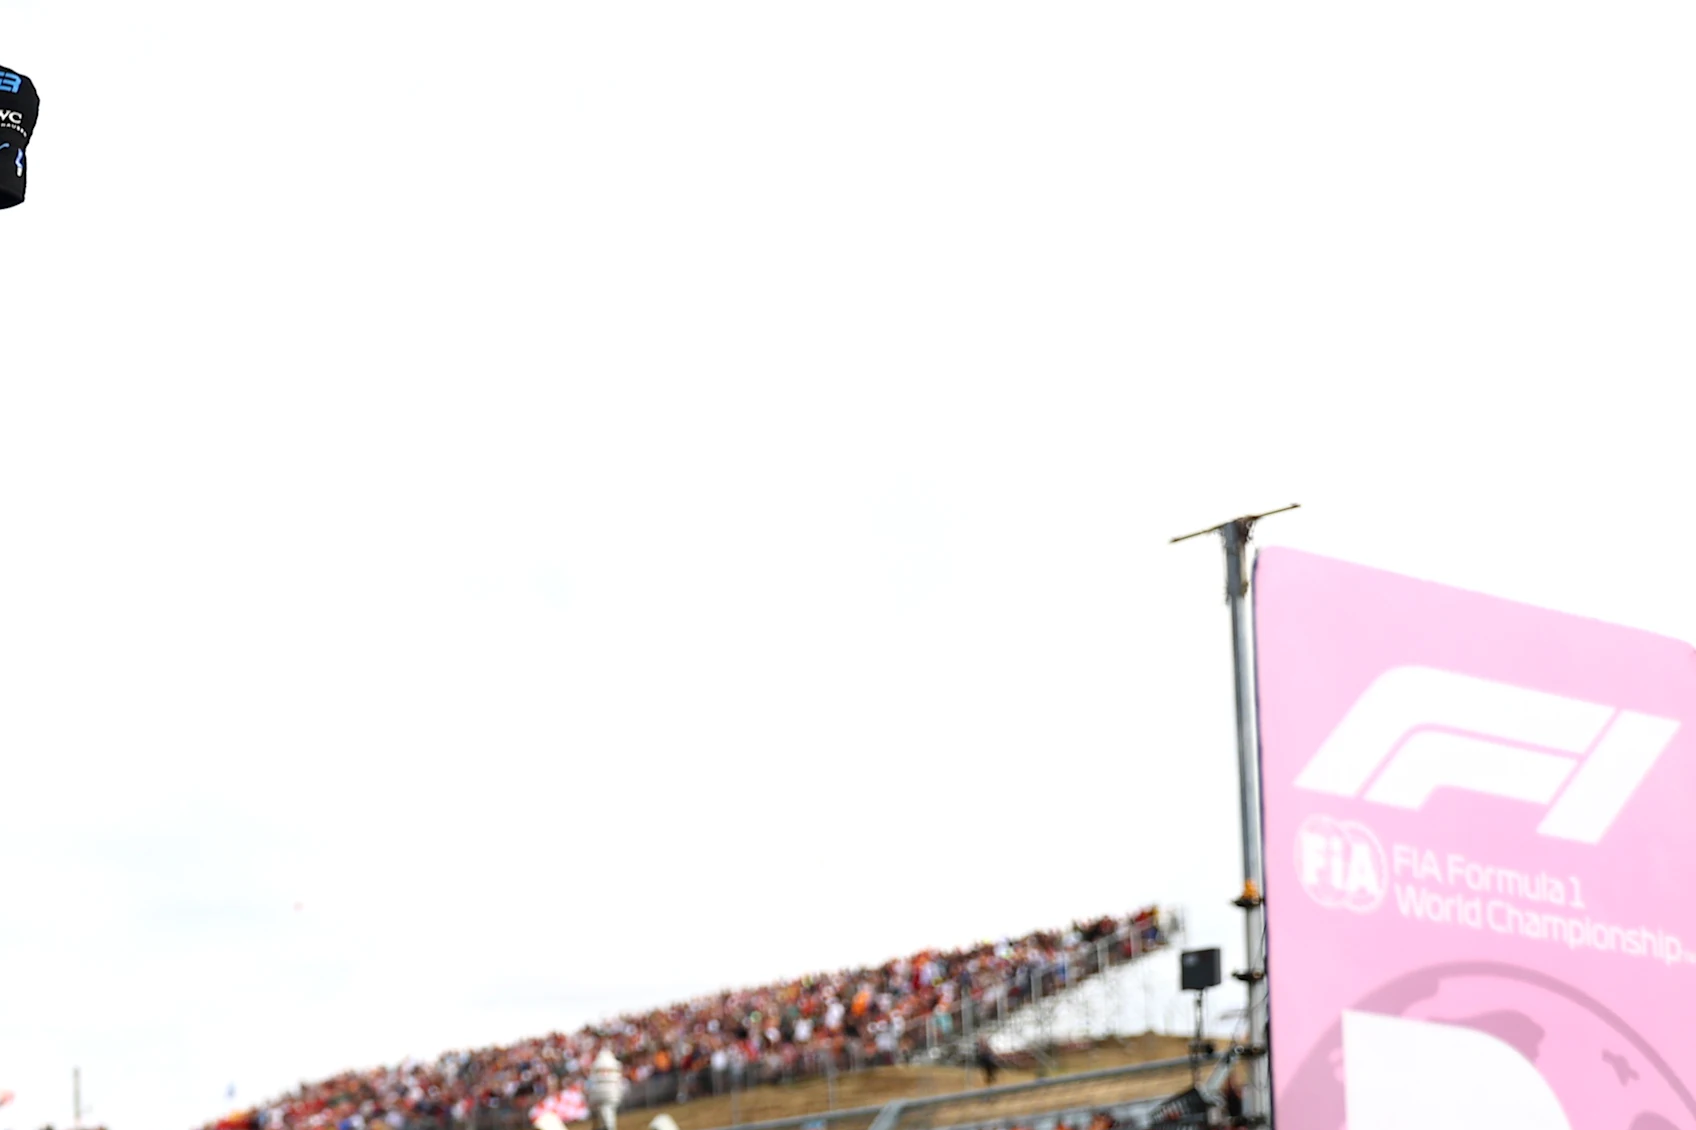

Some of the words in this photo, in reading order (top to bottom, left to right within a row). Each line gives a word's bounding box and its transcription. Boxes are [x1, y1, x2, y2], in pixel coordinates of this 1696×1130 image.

[1293, 665, 1682, 845] F1
[1393, 843, 1444, 884] FIA
[1447, 852, 1568, 905] Formula
[1570, 875, 1587, 910] 1
[1394, 882, 1484, 931] World
[1487, 898, 1682, 967] Championship
